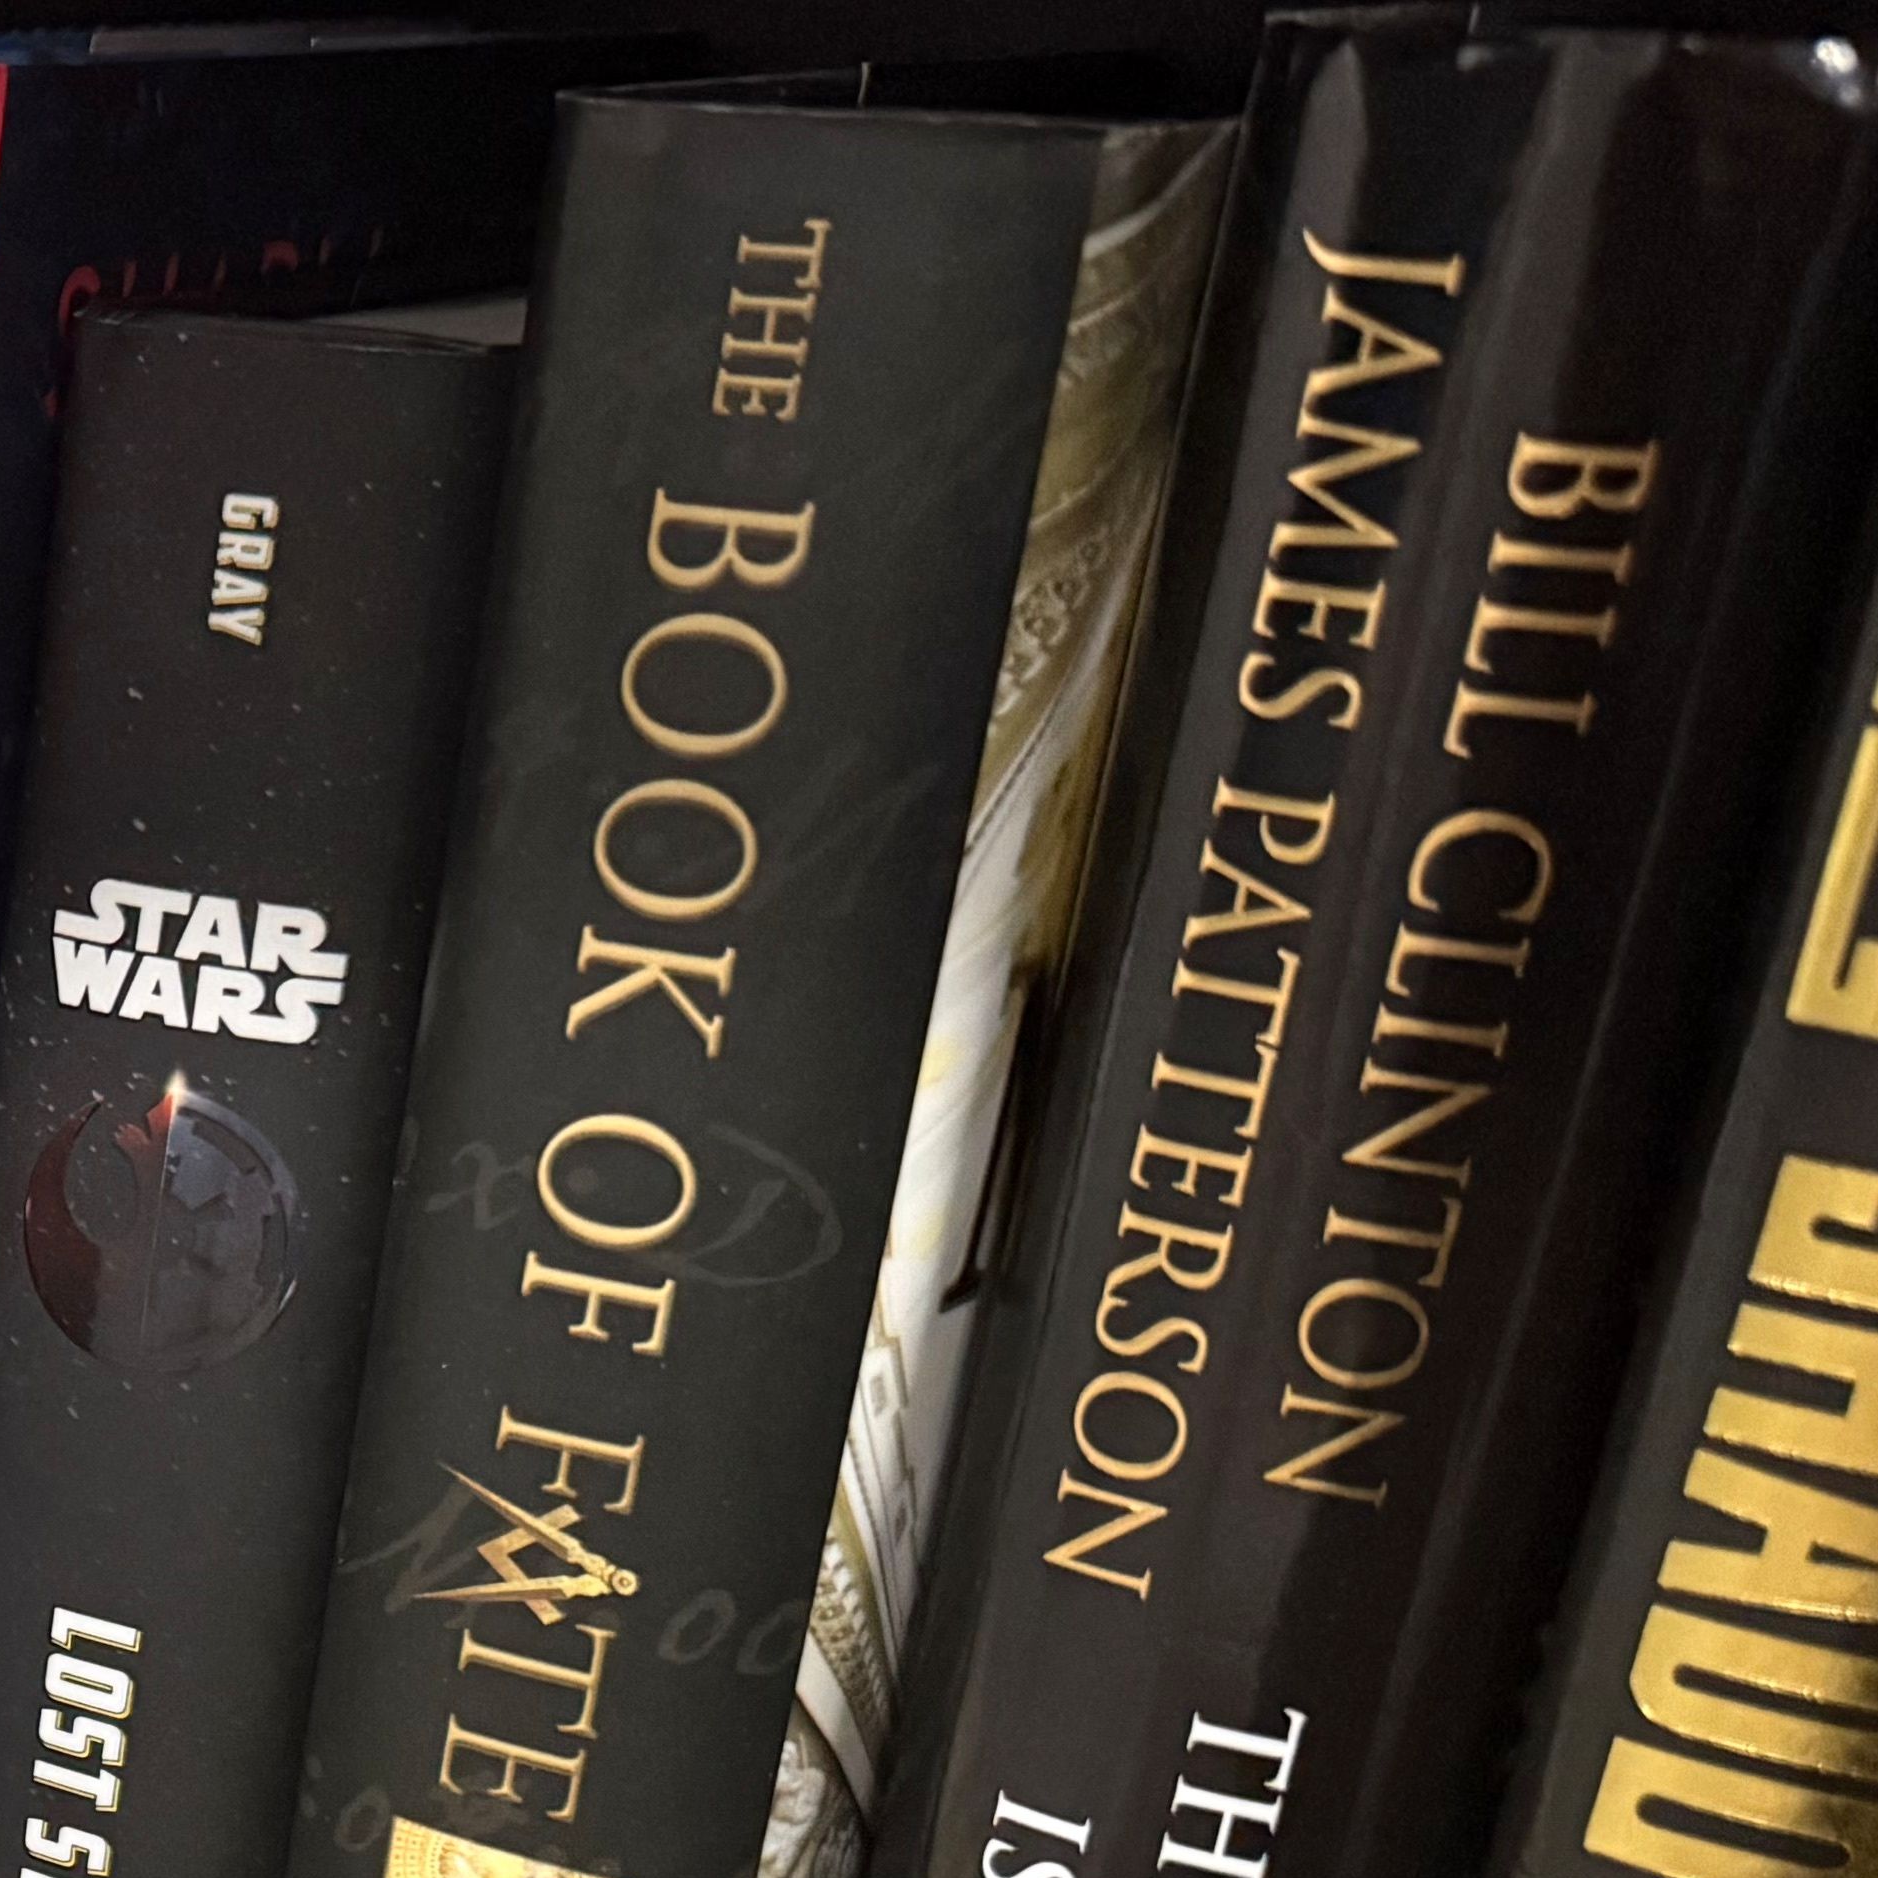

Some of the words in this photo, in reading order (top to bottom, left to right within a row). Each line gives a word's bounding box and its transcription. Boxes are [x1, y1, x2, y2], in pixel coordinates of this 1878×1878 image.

[711, 218, 832, 423] THE
[207, 492, 279, 646] GRAY
[1238, 226, 1466, 731] JAMES
[1443, 431, 1661, 758] BILL
[566, 486, 818, 1060] BOOK
[53, 936, 345, 1045] WARS
[54, 878, 349, 980] STAR
[522, 1112, 697, 1357] OF
[1042, 774, 1336, 1601] PATTERSON
[1262, 807, 1553, 1509] CLINTON
[33, 1605, 143, 1813] LOST
